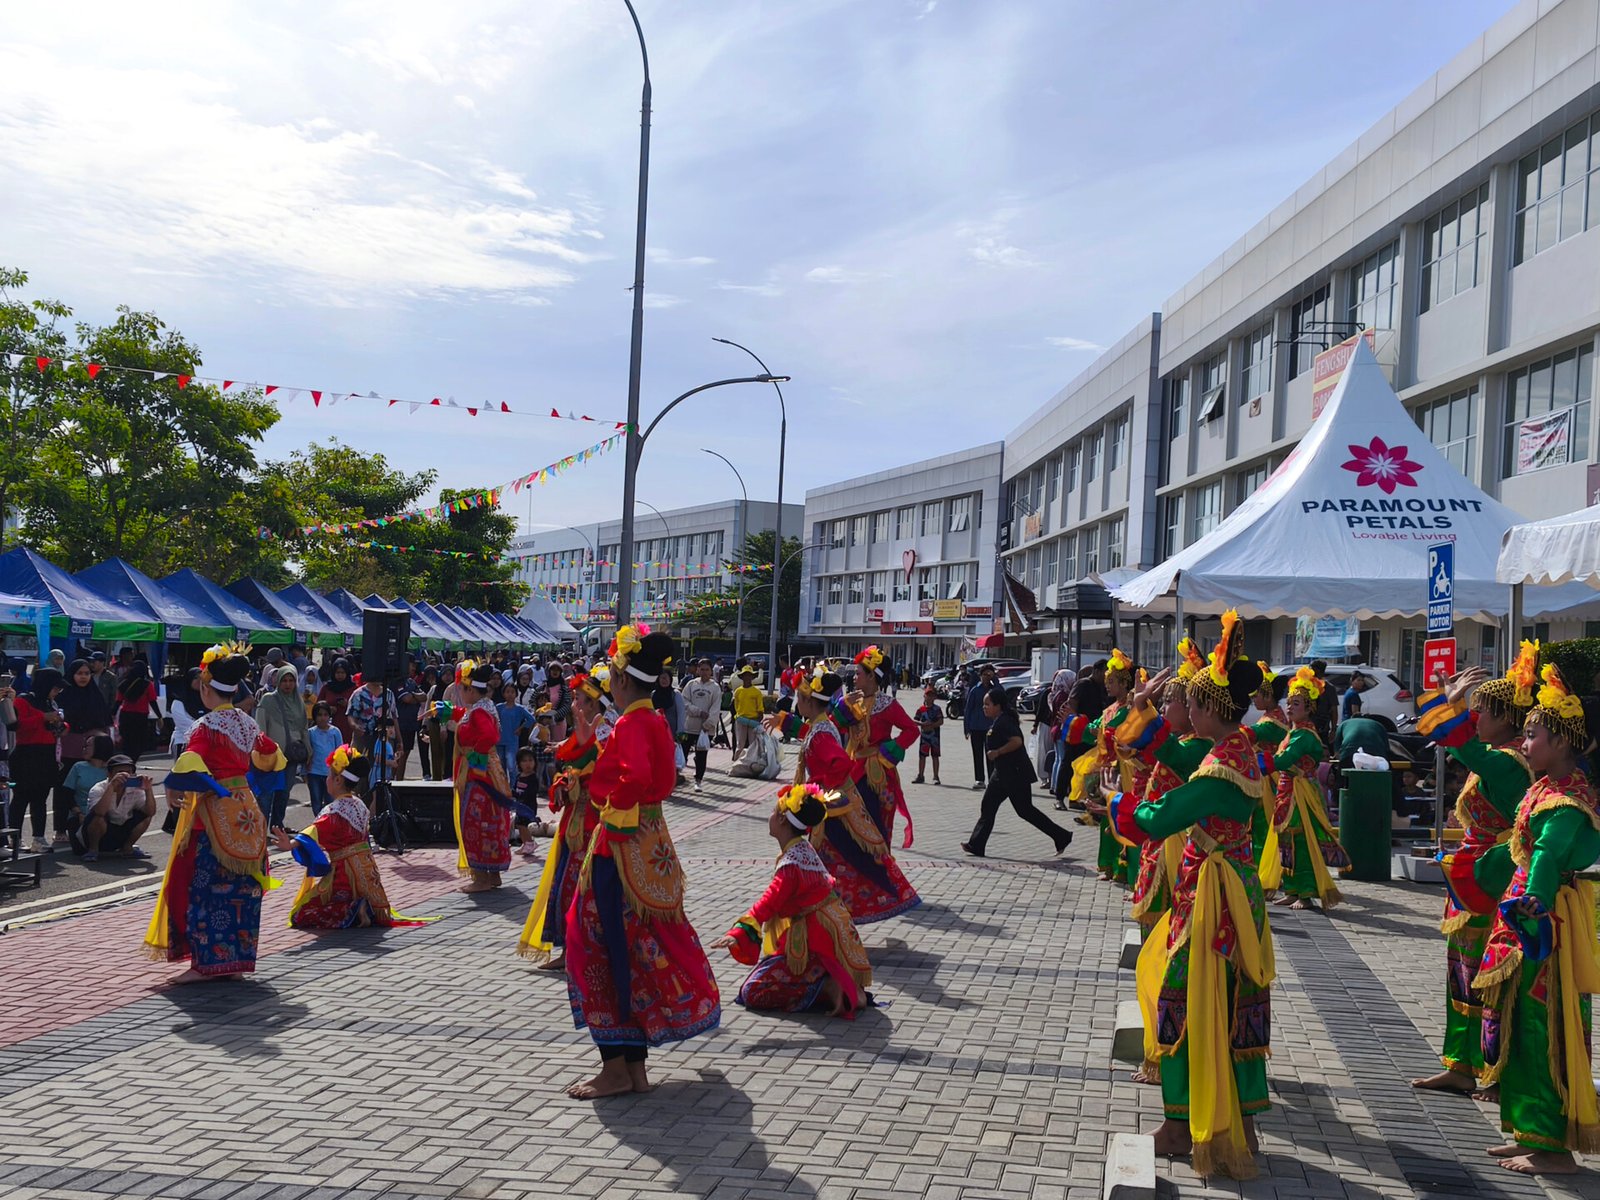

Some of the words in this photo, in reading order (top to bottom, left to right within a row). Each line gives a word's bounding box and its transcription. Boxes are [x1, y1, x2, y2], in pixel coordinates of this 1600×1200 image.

[1302, 499, 1482, 513] PARAMOUNT
[1346, 516, 1452, 529] PETALS
[1352, 532, 1408, 540] Lovable
[1412, 532, 1457, 541] Living
[1429, 551, 1437, 577] P
[1430, 604, 1450, 616] PARKIR
[1430, 616, 1450, 628] MOTOR
